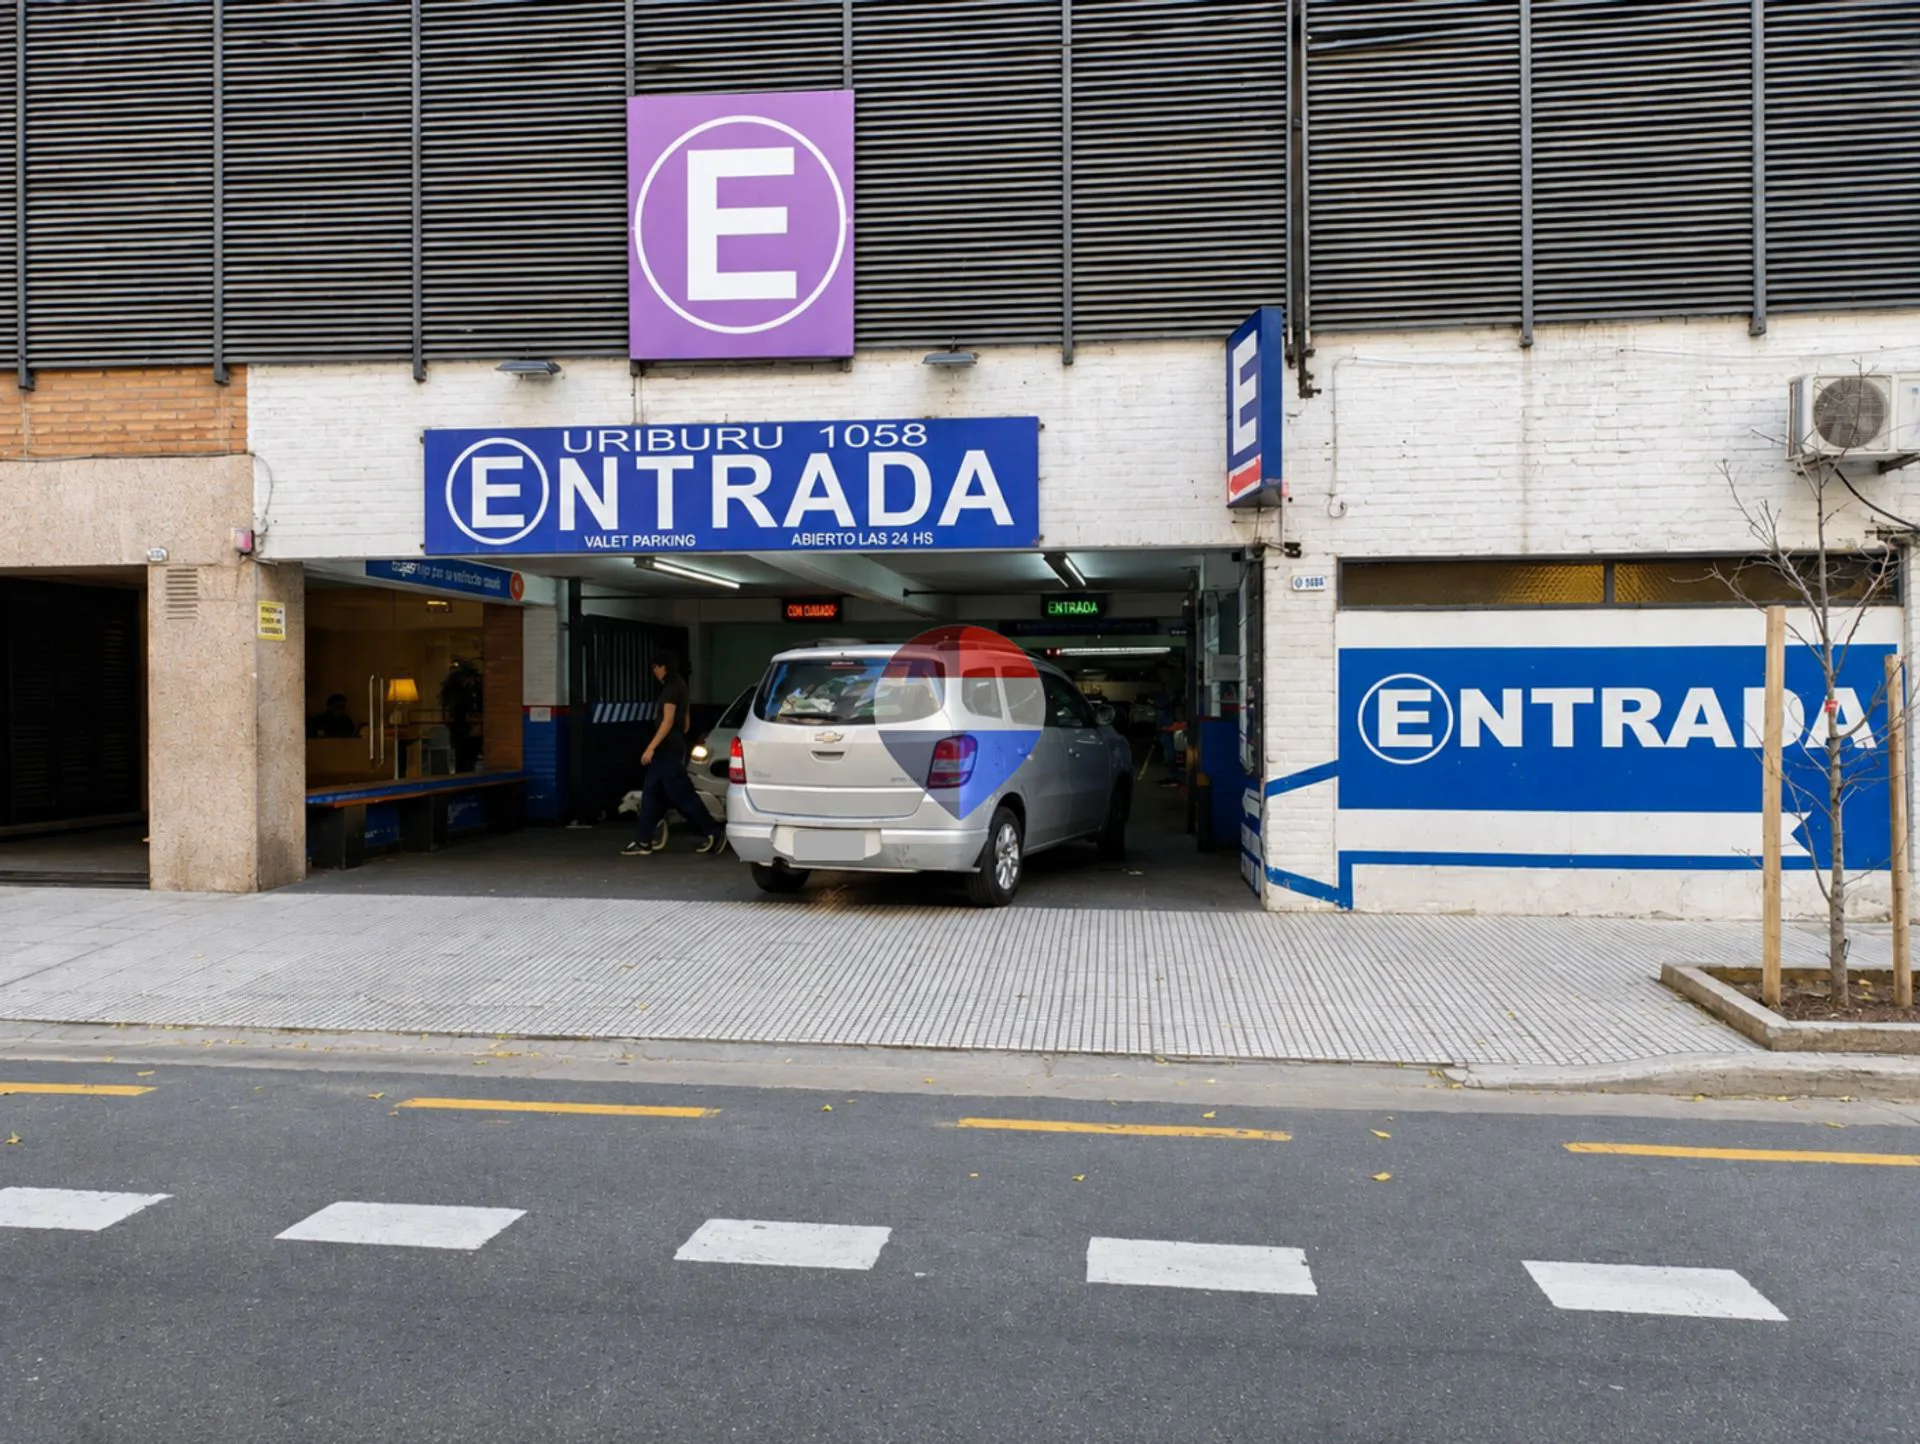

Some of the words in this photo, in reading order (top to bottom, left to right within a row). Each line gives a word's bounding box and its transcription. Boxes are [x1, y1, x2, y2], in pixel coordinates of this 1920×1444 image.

[686, 146, 798, 301] E
[1232, 329, 1257, 457] E
[563, 425, 784, 453] URIBURU
[819, 423, 928, 449] 1058
[470, 449, 1015, 531] ENTRADA
[584, 535, 629, 548] VALET
[632, 534, 696, 547] PARKING
[791, 533, 856, 546] ABIERTO
[858, 532, 888, 545] LAS
[891, 532, 908, 545] 24
[913, 532, 934, 545] HS
[1047, 601, 1098, 614] ENTRADA
[1378, 687, 1877, 748] ENTRADA
